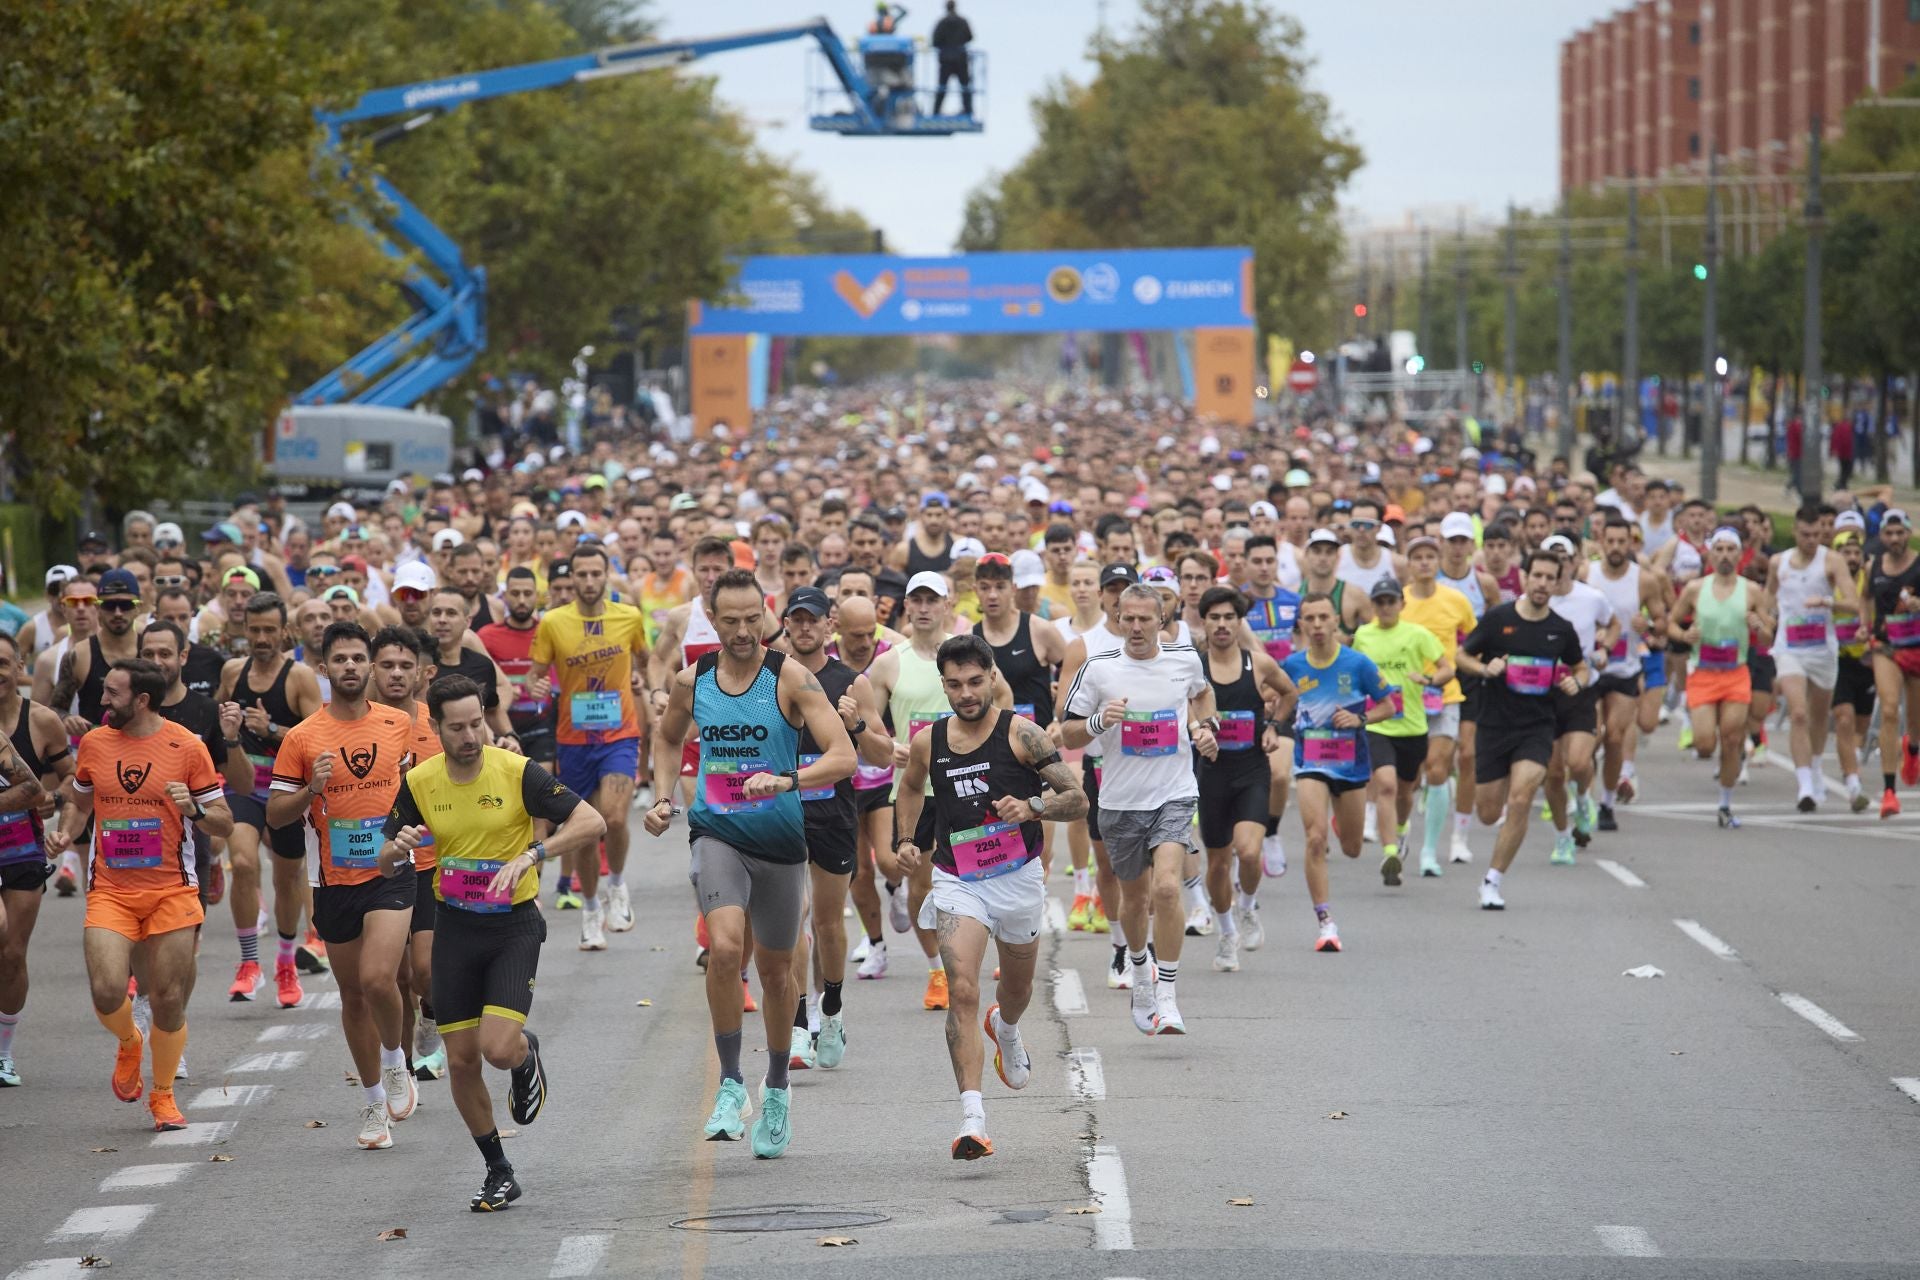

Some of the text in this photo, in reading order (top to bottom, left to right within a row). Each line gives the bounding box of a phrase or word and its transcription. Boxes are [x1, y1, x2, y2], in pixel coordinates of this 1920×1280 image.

[566, 645, 623, 667] OXY TRAIL
[701, 725, 768, 741] CRESPO
[1139, 725, 1159, 734] 2061
[1142, 738, 1158, 746] DOM
[711, 746, 761, 757] RUNNERS
[328, 779, 392, 793] PETIT COMITÉ
[100, 796, 123, 804] PETIT
[731, 792, 747, 801] TON
[117, 834, 140, 843] 2122
[348, 832, 373, 843] 2029
[975, 838, 1002, 853] 2294
[115, 848, 144, 856] ERNEST
[349, 847, 374, 856] Antoni
[977, 852, 1008, 868] Carrete
[462, 875, 490, 886] 3050
[465, 891, 485, 900] PUPI
